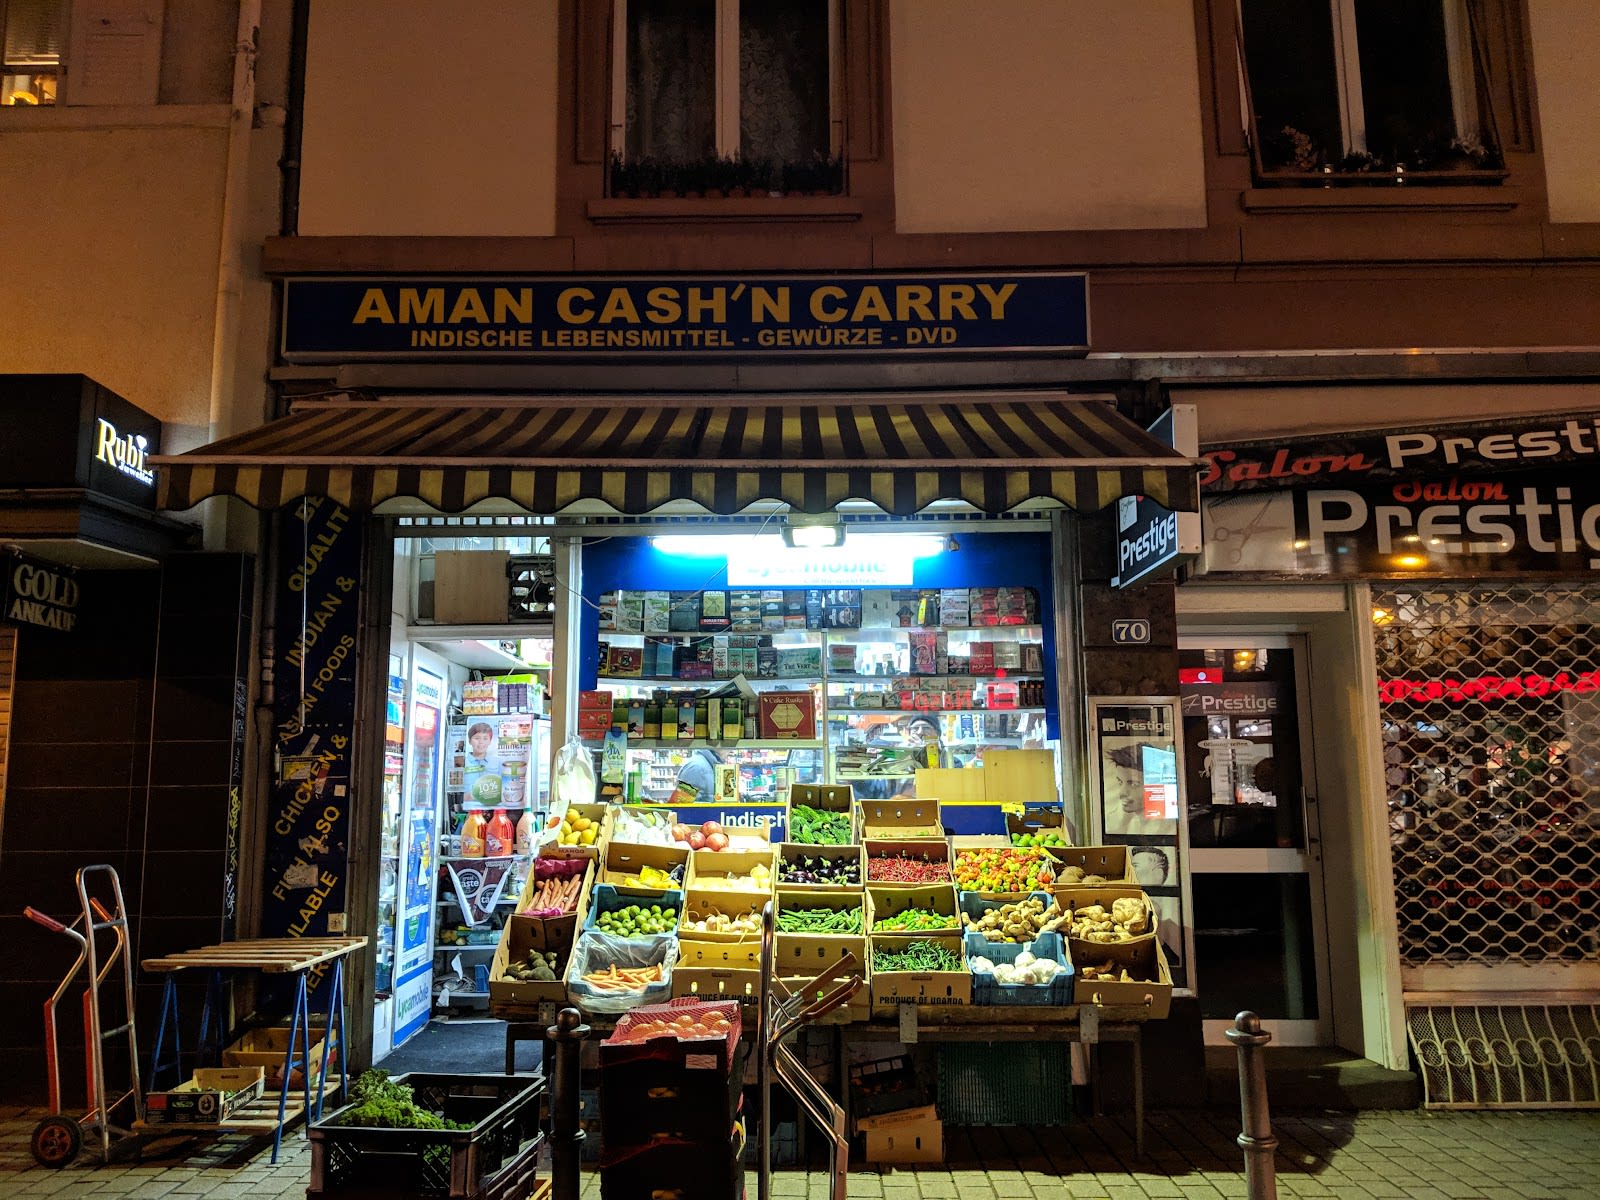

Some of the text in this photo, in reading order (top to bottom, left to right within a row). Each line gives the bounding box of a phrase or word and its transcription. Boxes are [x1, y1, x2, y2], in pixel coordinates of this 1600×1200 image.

[352, 288, 533, 324] AMAN
[809, 283, 1018, 323] CARRY
[411, 329, 533, 347] INDISCHE
[542, 328, 734, 347] LEBENSMITTEL
[757, 326, 883, 347] GEWÜRZE
[906, 327, 958, 345] DVD
[96, 418, 153, 477] Rubi
[1200, 448, 1375, 485] Salon
[1120, 512, 1175, 572] Prestige
[14, 564, 80, 608] GOLD
[9, 598, 77, 631] ANKAUF
[285, 575, 357, 669] INDIAN &
[1115, 622, 1147, 641] 70
[312, 634, 355, 693] FOODS
[1201, 694, 1278, 712] Prestige
[330, 733, 349, 750] &
[1116, 720, 1171, 733] Prestige
[720, 811, 786, 827] Indisch
[272, 855, 310, 903] FIH
[462, 879, 480, 888] aste
[879, 996, 917, 1004] PRODUCE
[930, 997, 964, 1005] UGANDA
